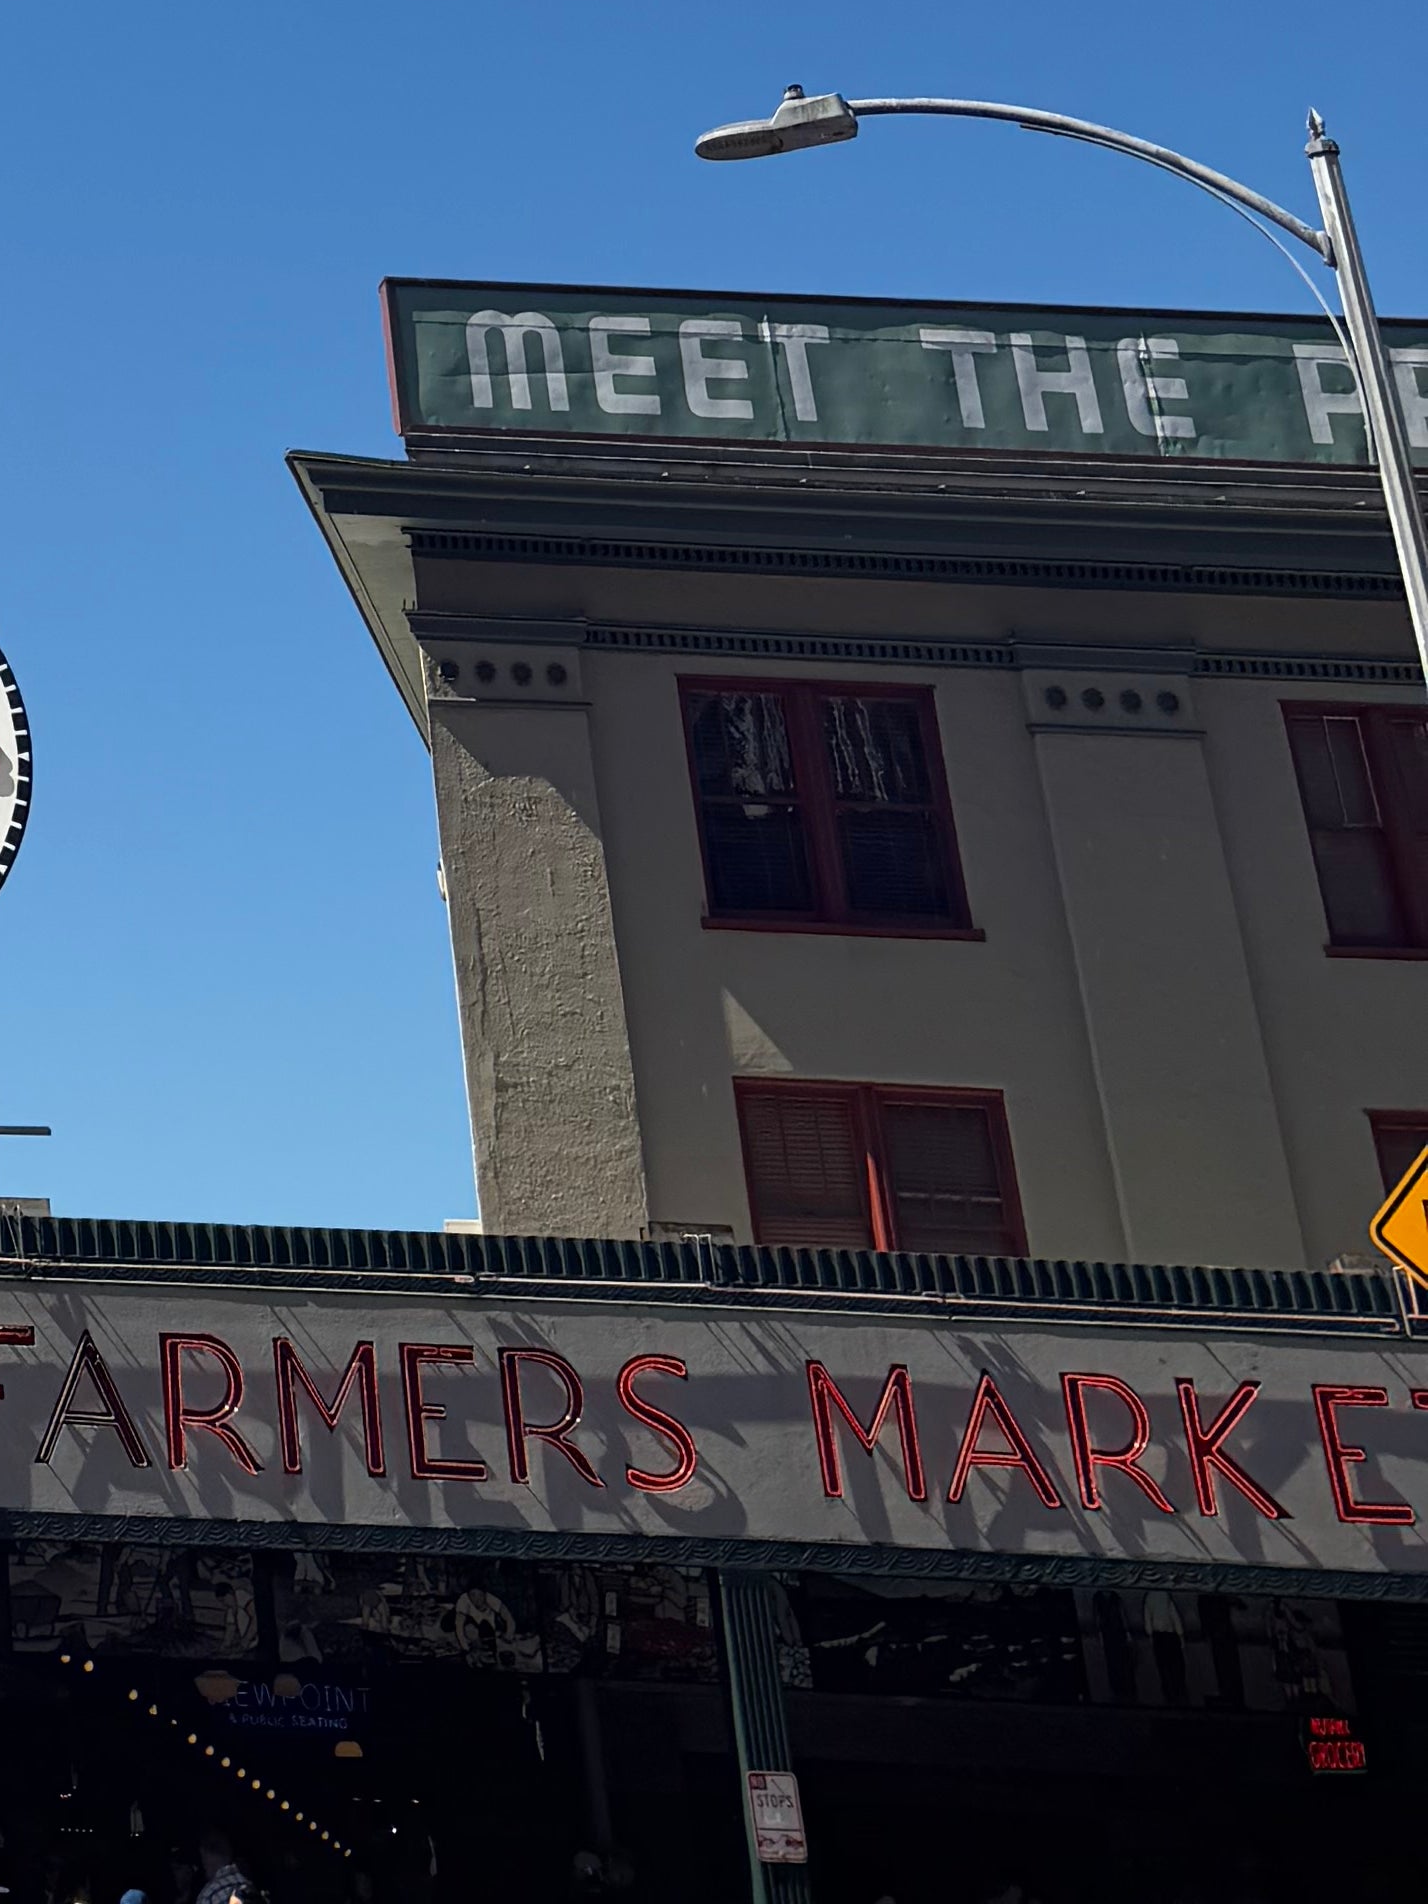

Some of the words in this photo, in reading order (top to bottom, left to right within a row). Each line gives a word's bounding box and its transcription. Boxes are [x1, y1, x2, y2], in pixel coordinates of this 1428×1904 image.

[466, 309, 832, 423] MEET
[919, 327, 1196, 439] THE
[291, 1714, 349, 1730] SEATING
